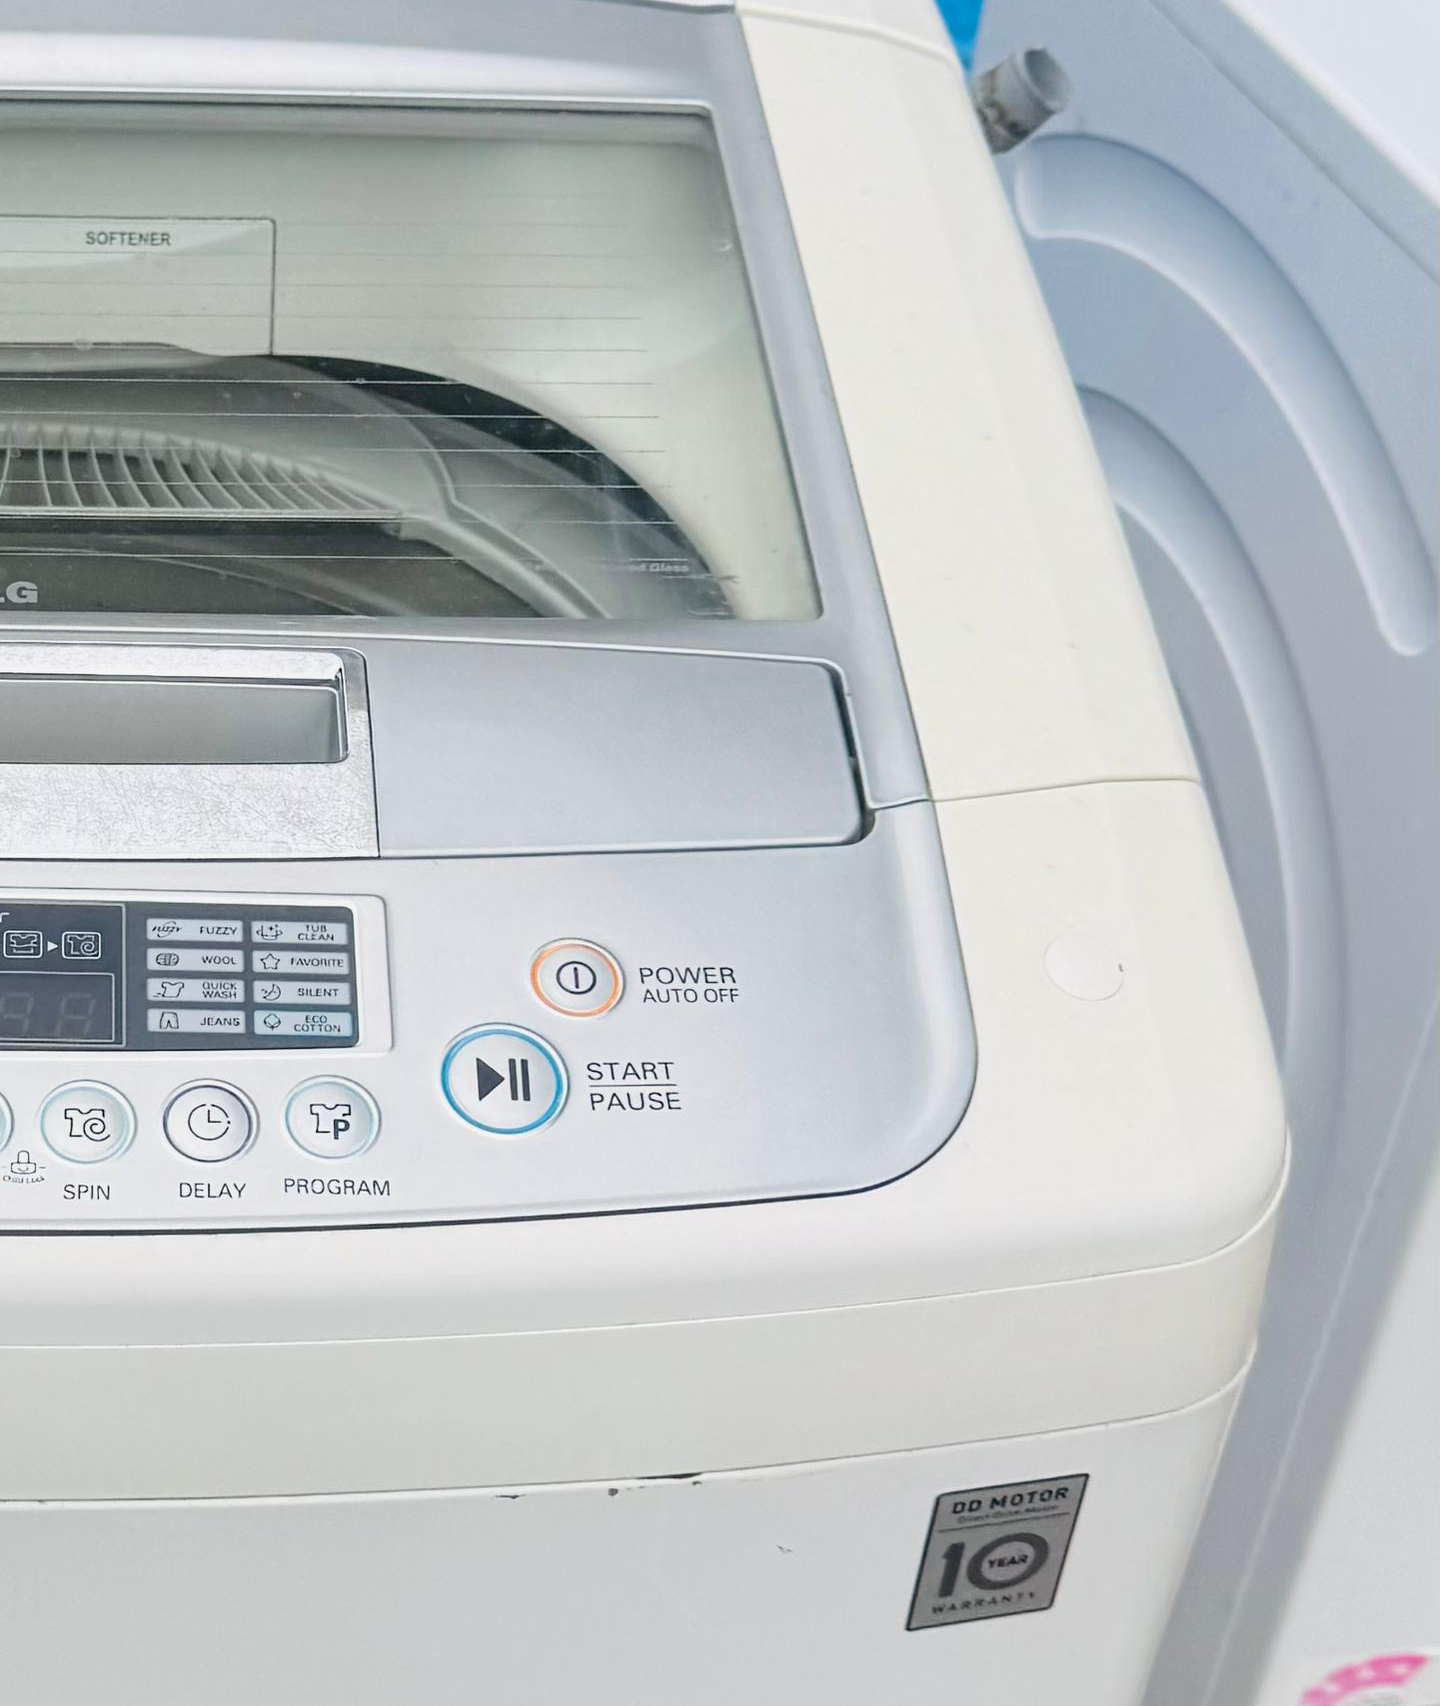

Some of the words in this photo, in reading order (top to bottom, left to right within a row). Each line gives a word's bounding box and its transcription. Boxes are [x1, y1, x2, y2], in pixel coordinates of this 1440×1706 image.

[85, 231, 172, 247] SOFTENER
[200, 926, 238, 936] FUZZY
[305, 924, 327, 933] TUB
[297, 932, 335, 942] CLEAN
[201, 955, 237, 966] WOOL
[290, 958, 345, 968] FAVORITE
[639, 966, 737, 985] POWER
[201, 981, 237, 990] QUICK
[201, 990, 237, 999] WASH
[298, 987, 339, 998] SILENT
[643, 988, 698, 1004] AUTO
[703, 988, 740, 1003] OFF
[200, 1017, 240, 1027] JEANS
[305, 1015, 328, 1024] ECO
[293, 1023, 341, 1033] COTTON
[586, 1062, 675, 1081] START
[589, 1091, 682, 1111] PAUSE
[63, 1183, 111, 1201] SPIN
[178, 1181, 247, 1199] DELAY
[283, 1177, 391, 1197] PROGRAM
[952, 1499, 982, 1515] DD
[989, 1487, 1069, 1510] MOTOR
[938, 1532, 1050, 1598] 10
[987, 1553, 1029, 1569] YEAR
